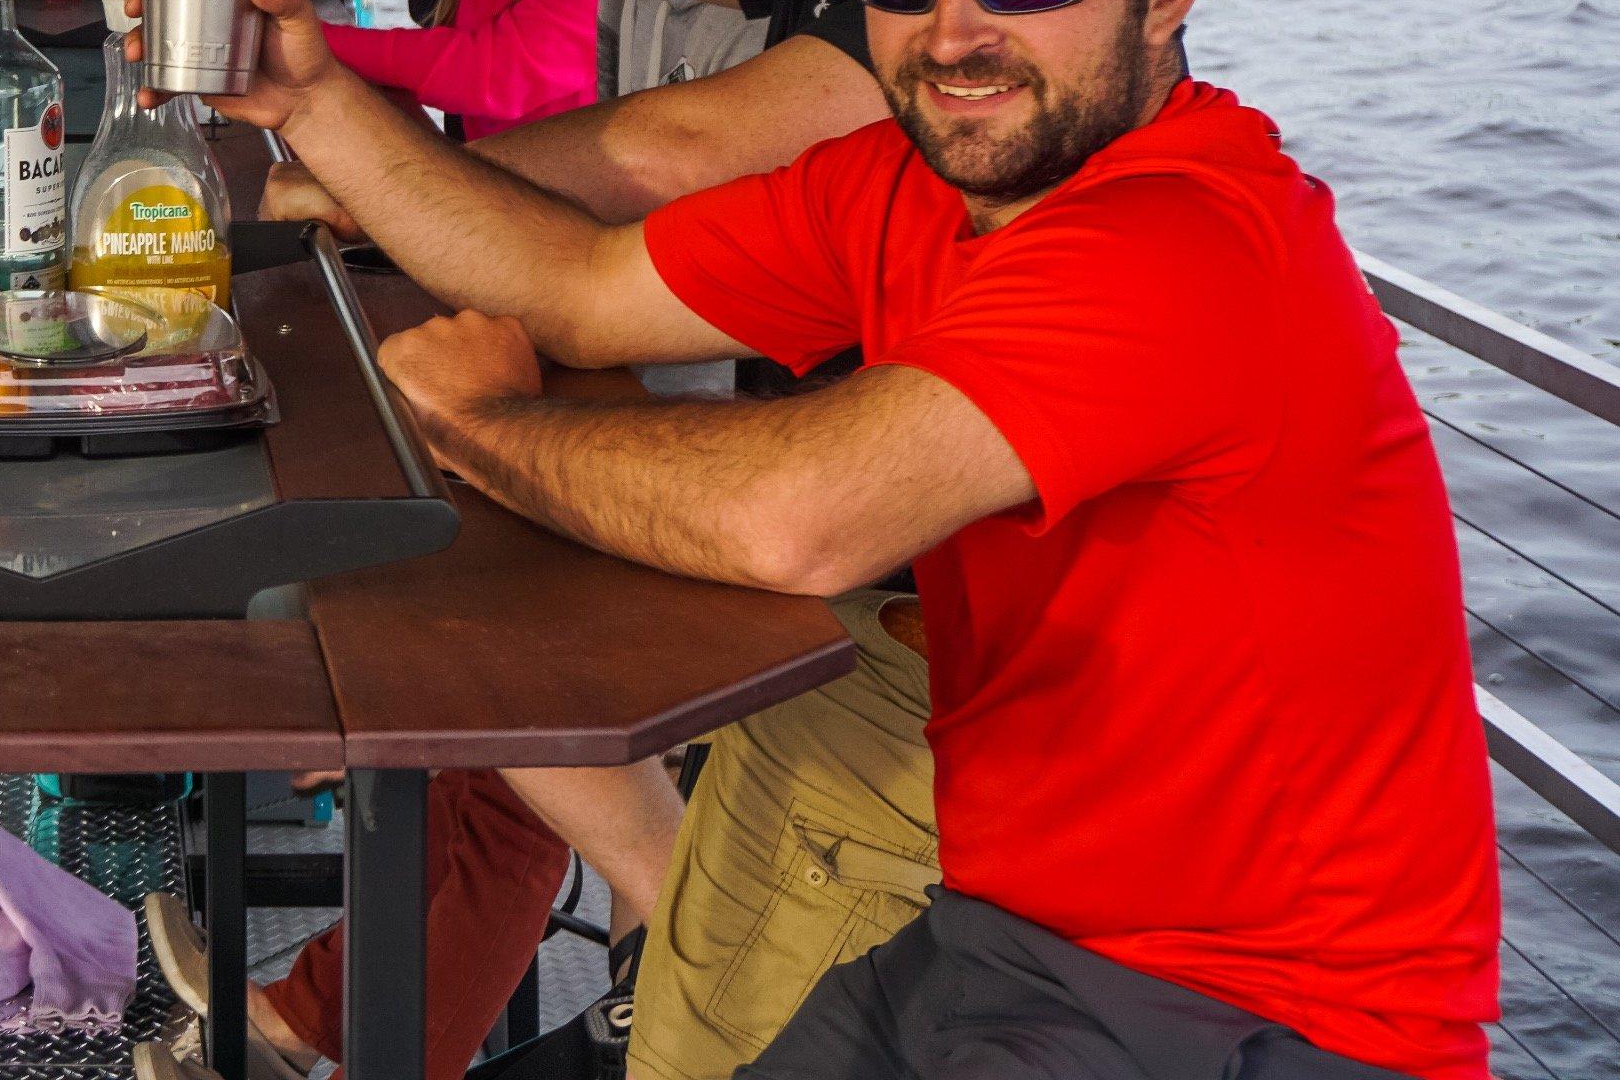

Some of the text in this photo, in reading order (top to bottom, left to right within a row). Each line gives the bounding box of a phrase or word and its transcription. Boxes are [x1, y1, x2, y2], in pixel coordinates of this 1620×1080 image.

[165, 39, 232, 68] YETI
[18, 154, 64, 181] BACA
[130, 202, 190, 222] Tropicana
[101, 228, 215, 256] PINEAPPLE MANGO
